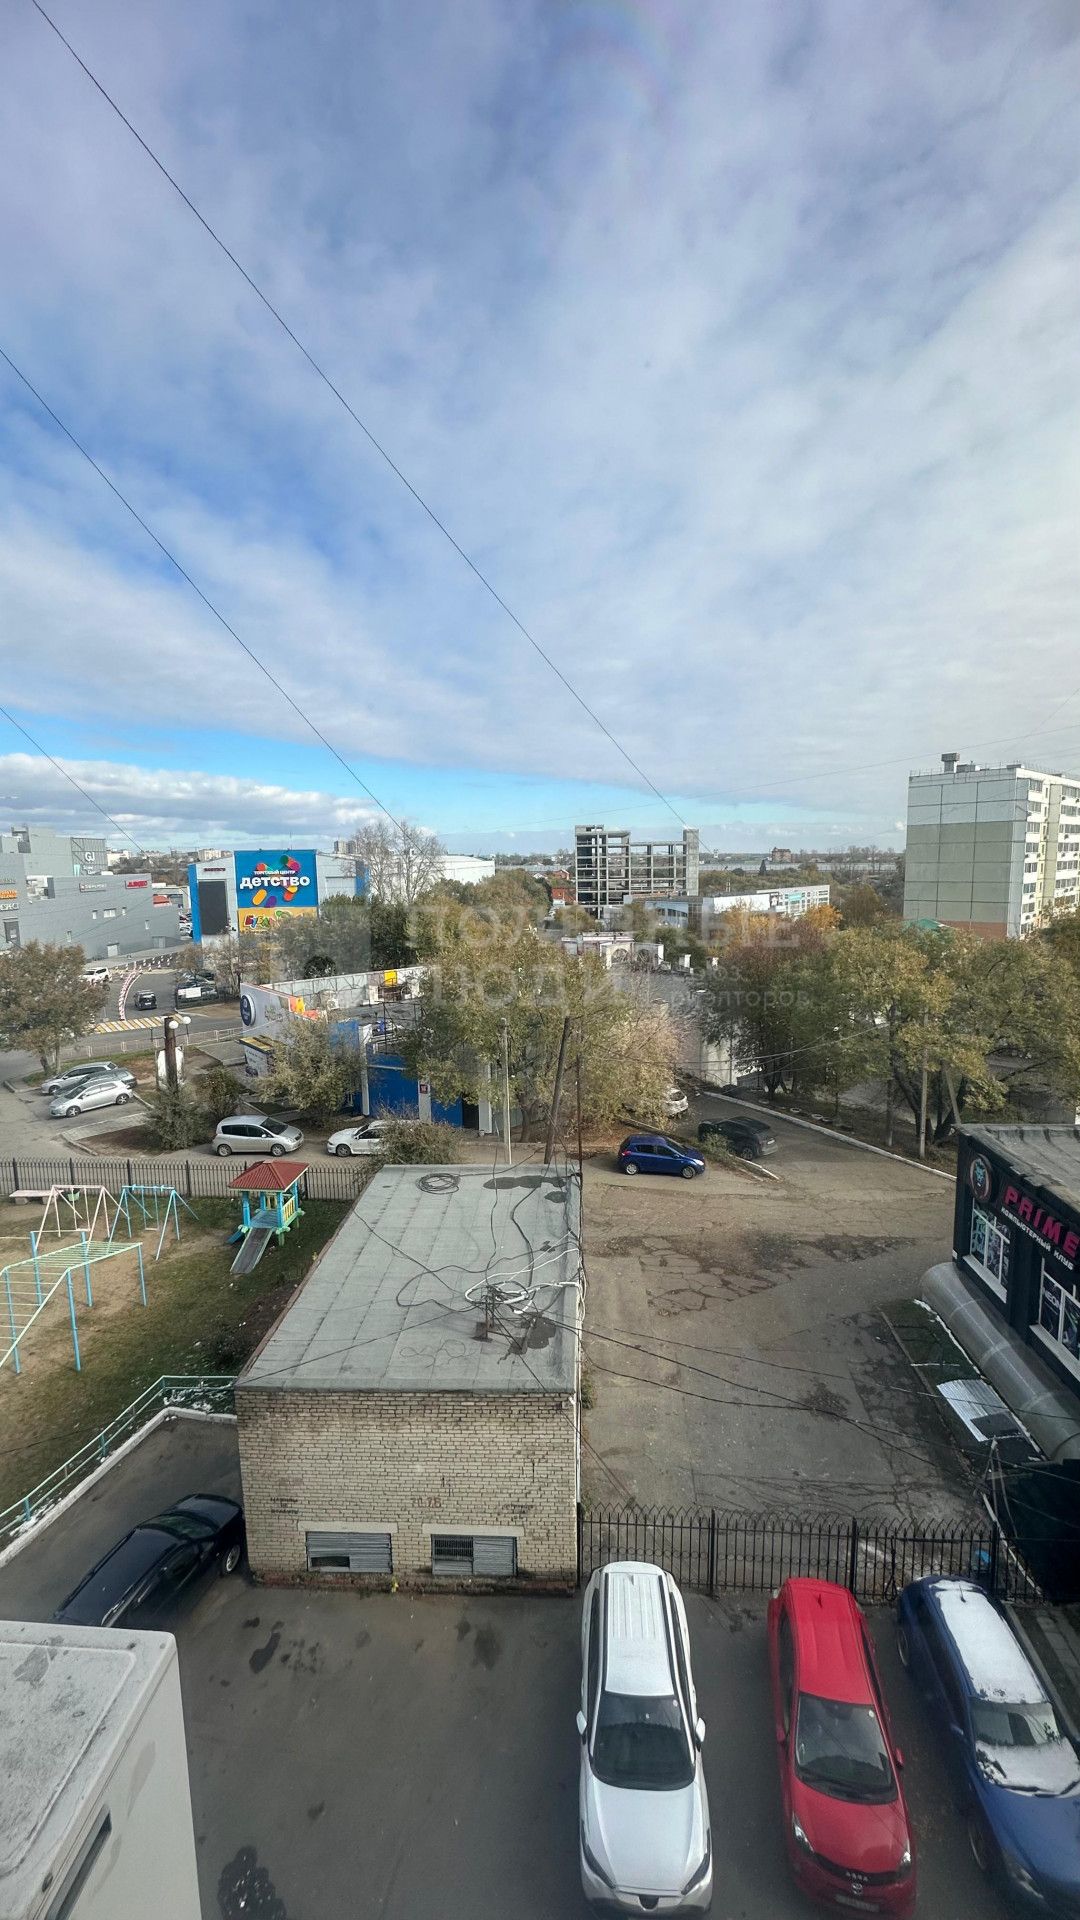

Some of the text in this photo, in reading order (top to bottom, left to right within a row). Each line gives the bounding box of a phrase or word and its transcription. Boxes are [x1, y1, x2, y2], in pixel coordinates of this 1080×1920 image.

[1001, 1206, 1075, 1271] КОМПЬЮТЕРНЫЙ КЛУБ
[1004, 1185, 1080, 1259] PRIME
